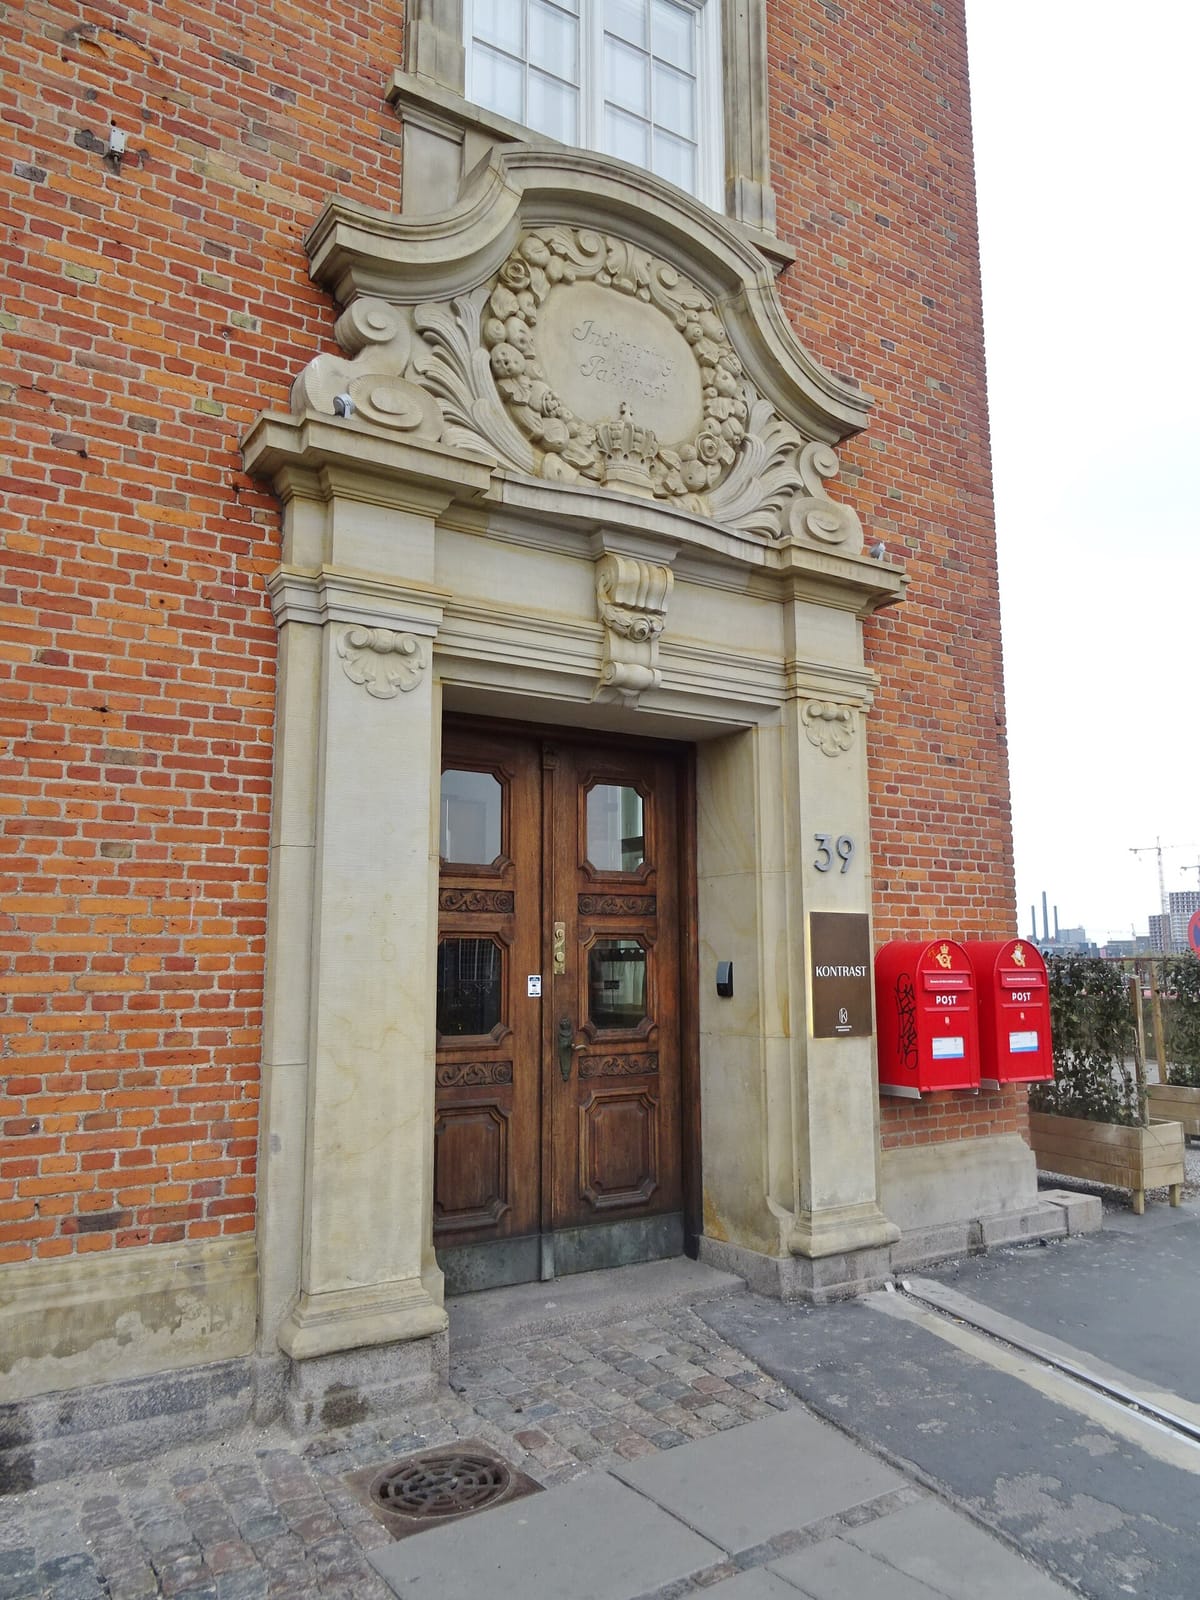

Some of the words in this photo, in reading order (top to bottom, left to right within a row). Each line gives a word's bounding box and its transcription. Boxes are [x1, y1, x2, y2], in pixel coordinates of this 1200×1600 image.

[814, 833, 854, 873] 39
[815, 965, 866, 977] KONTRAST
[935, 995, 957, 1005] POST
[1012, 992, 1031, 1001] POST
